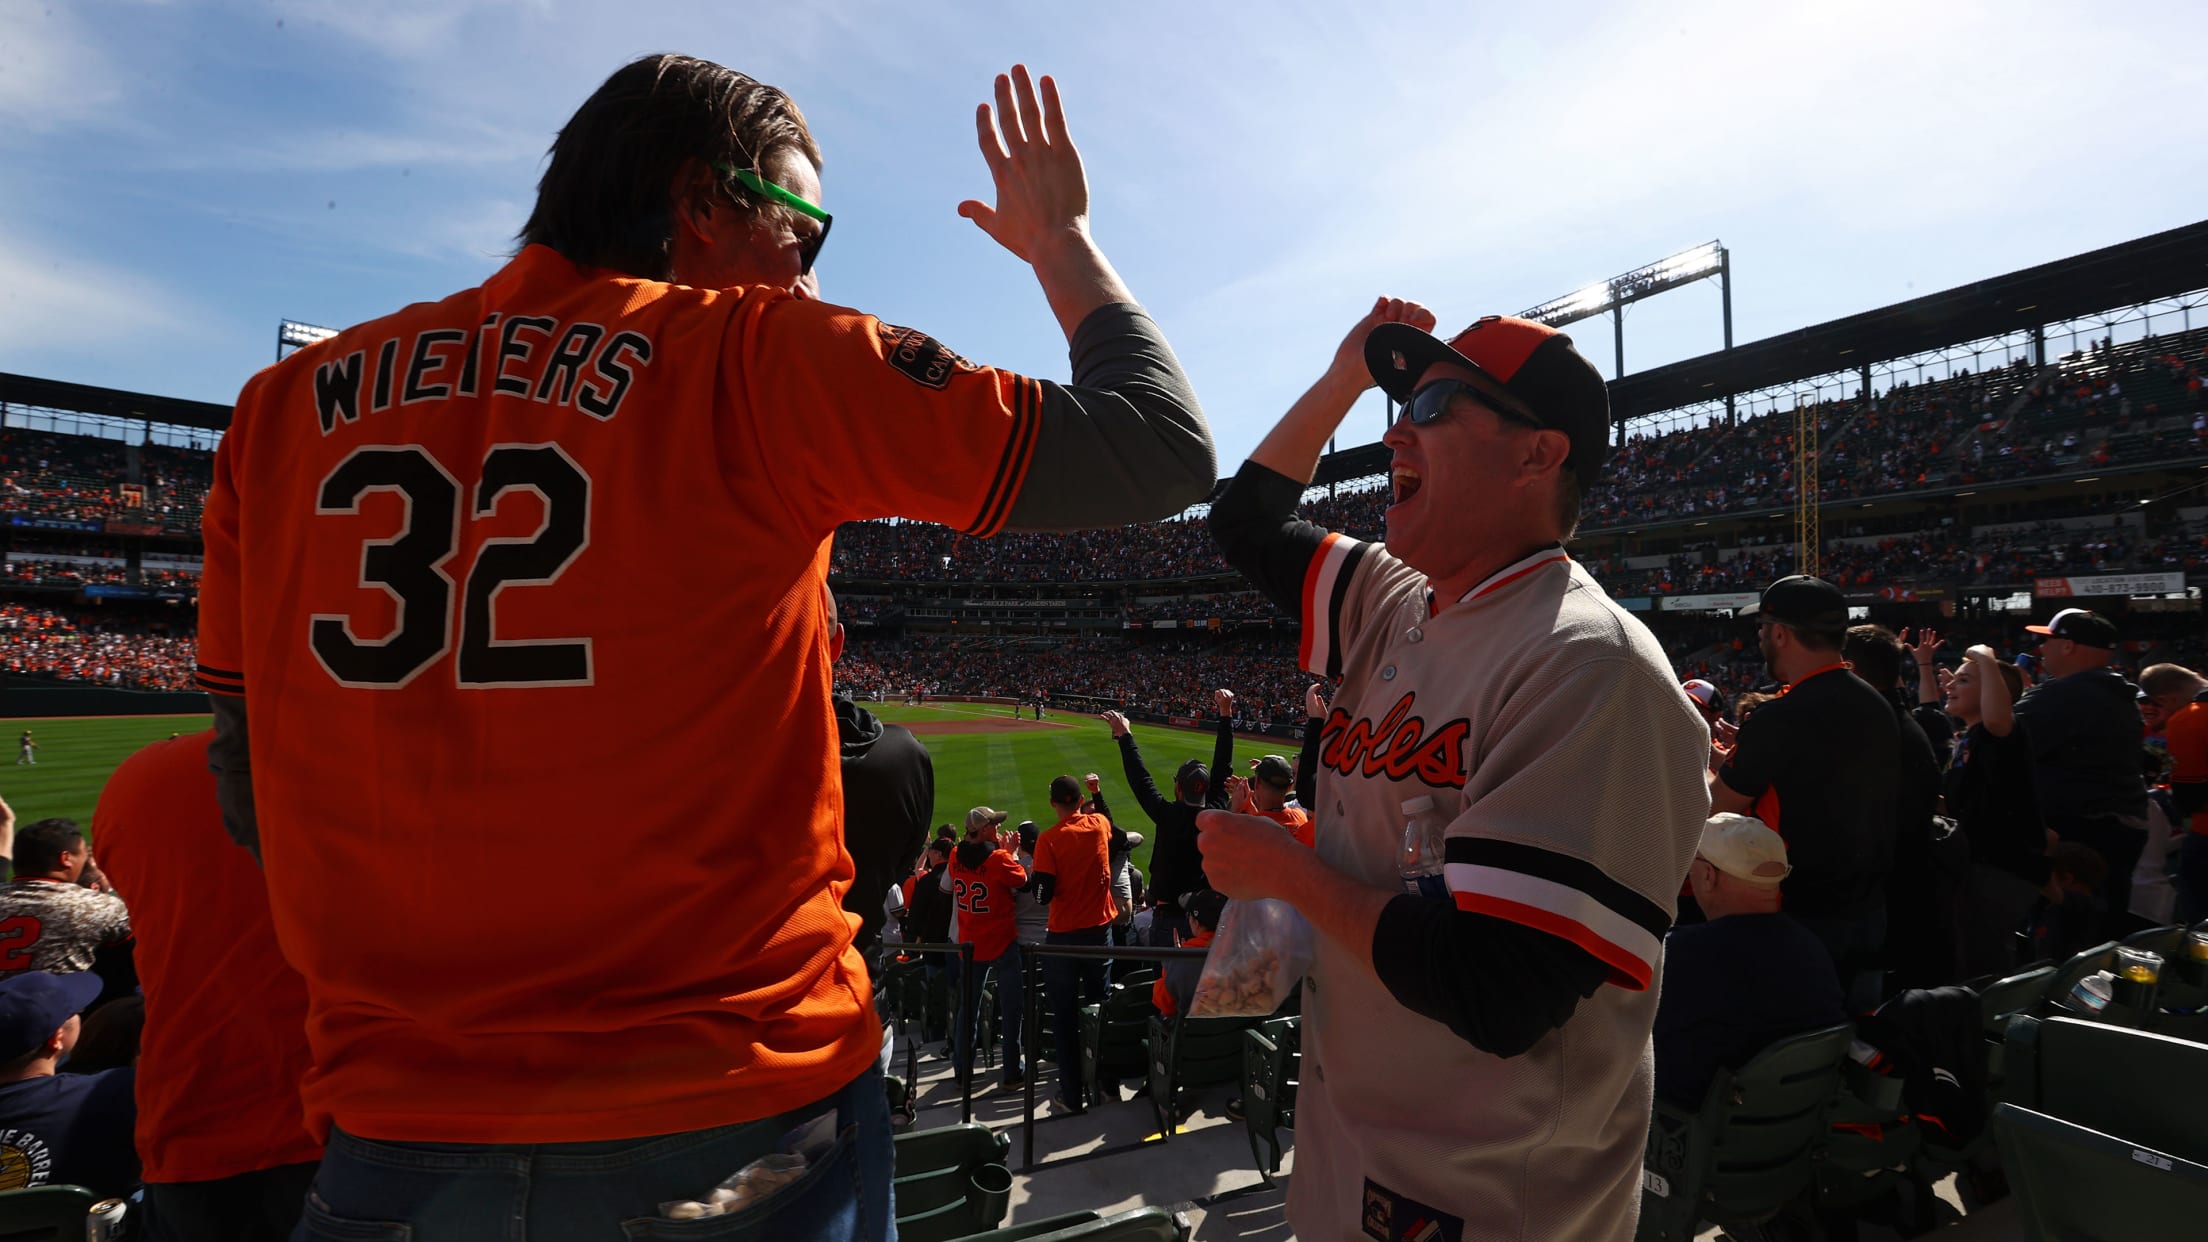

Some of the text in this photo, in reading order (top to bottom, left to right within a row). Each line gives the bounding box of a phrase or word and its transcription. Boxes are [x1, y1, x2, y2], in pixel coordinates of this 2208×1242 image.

[314, 312, 652, 437] WIETERS
[309, 440, 595, 690] 32
[954, 878, 990, 914] 22
[0, 915, 42, 971] 2
[16, 1132, 52, 1188] BARREL
[1648, 1173, 1662, 1192] 13
